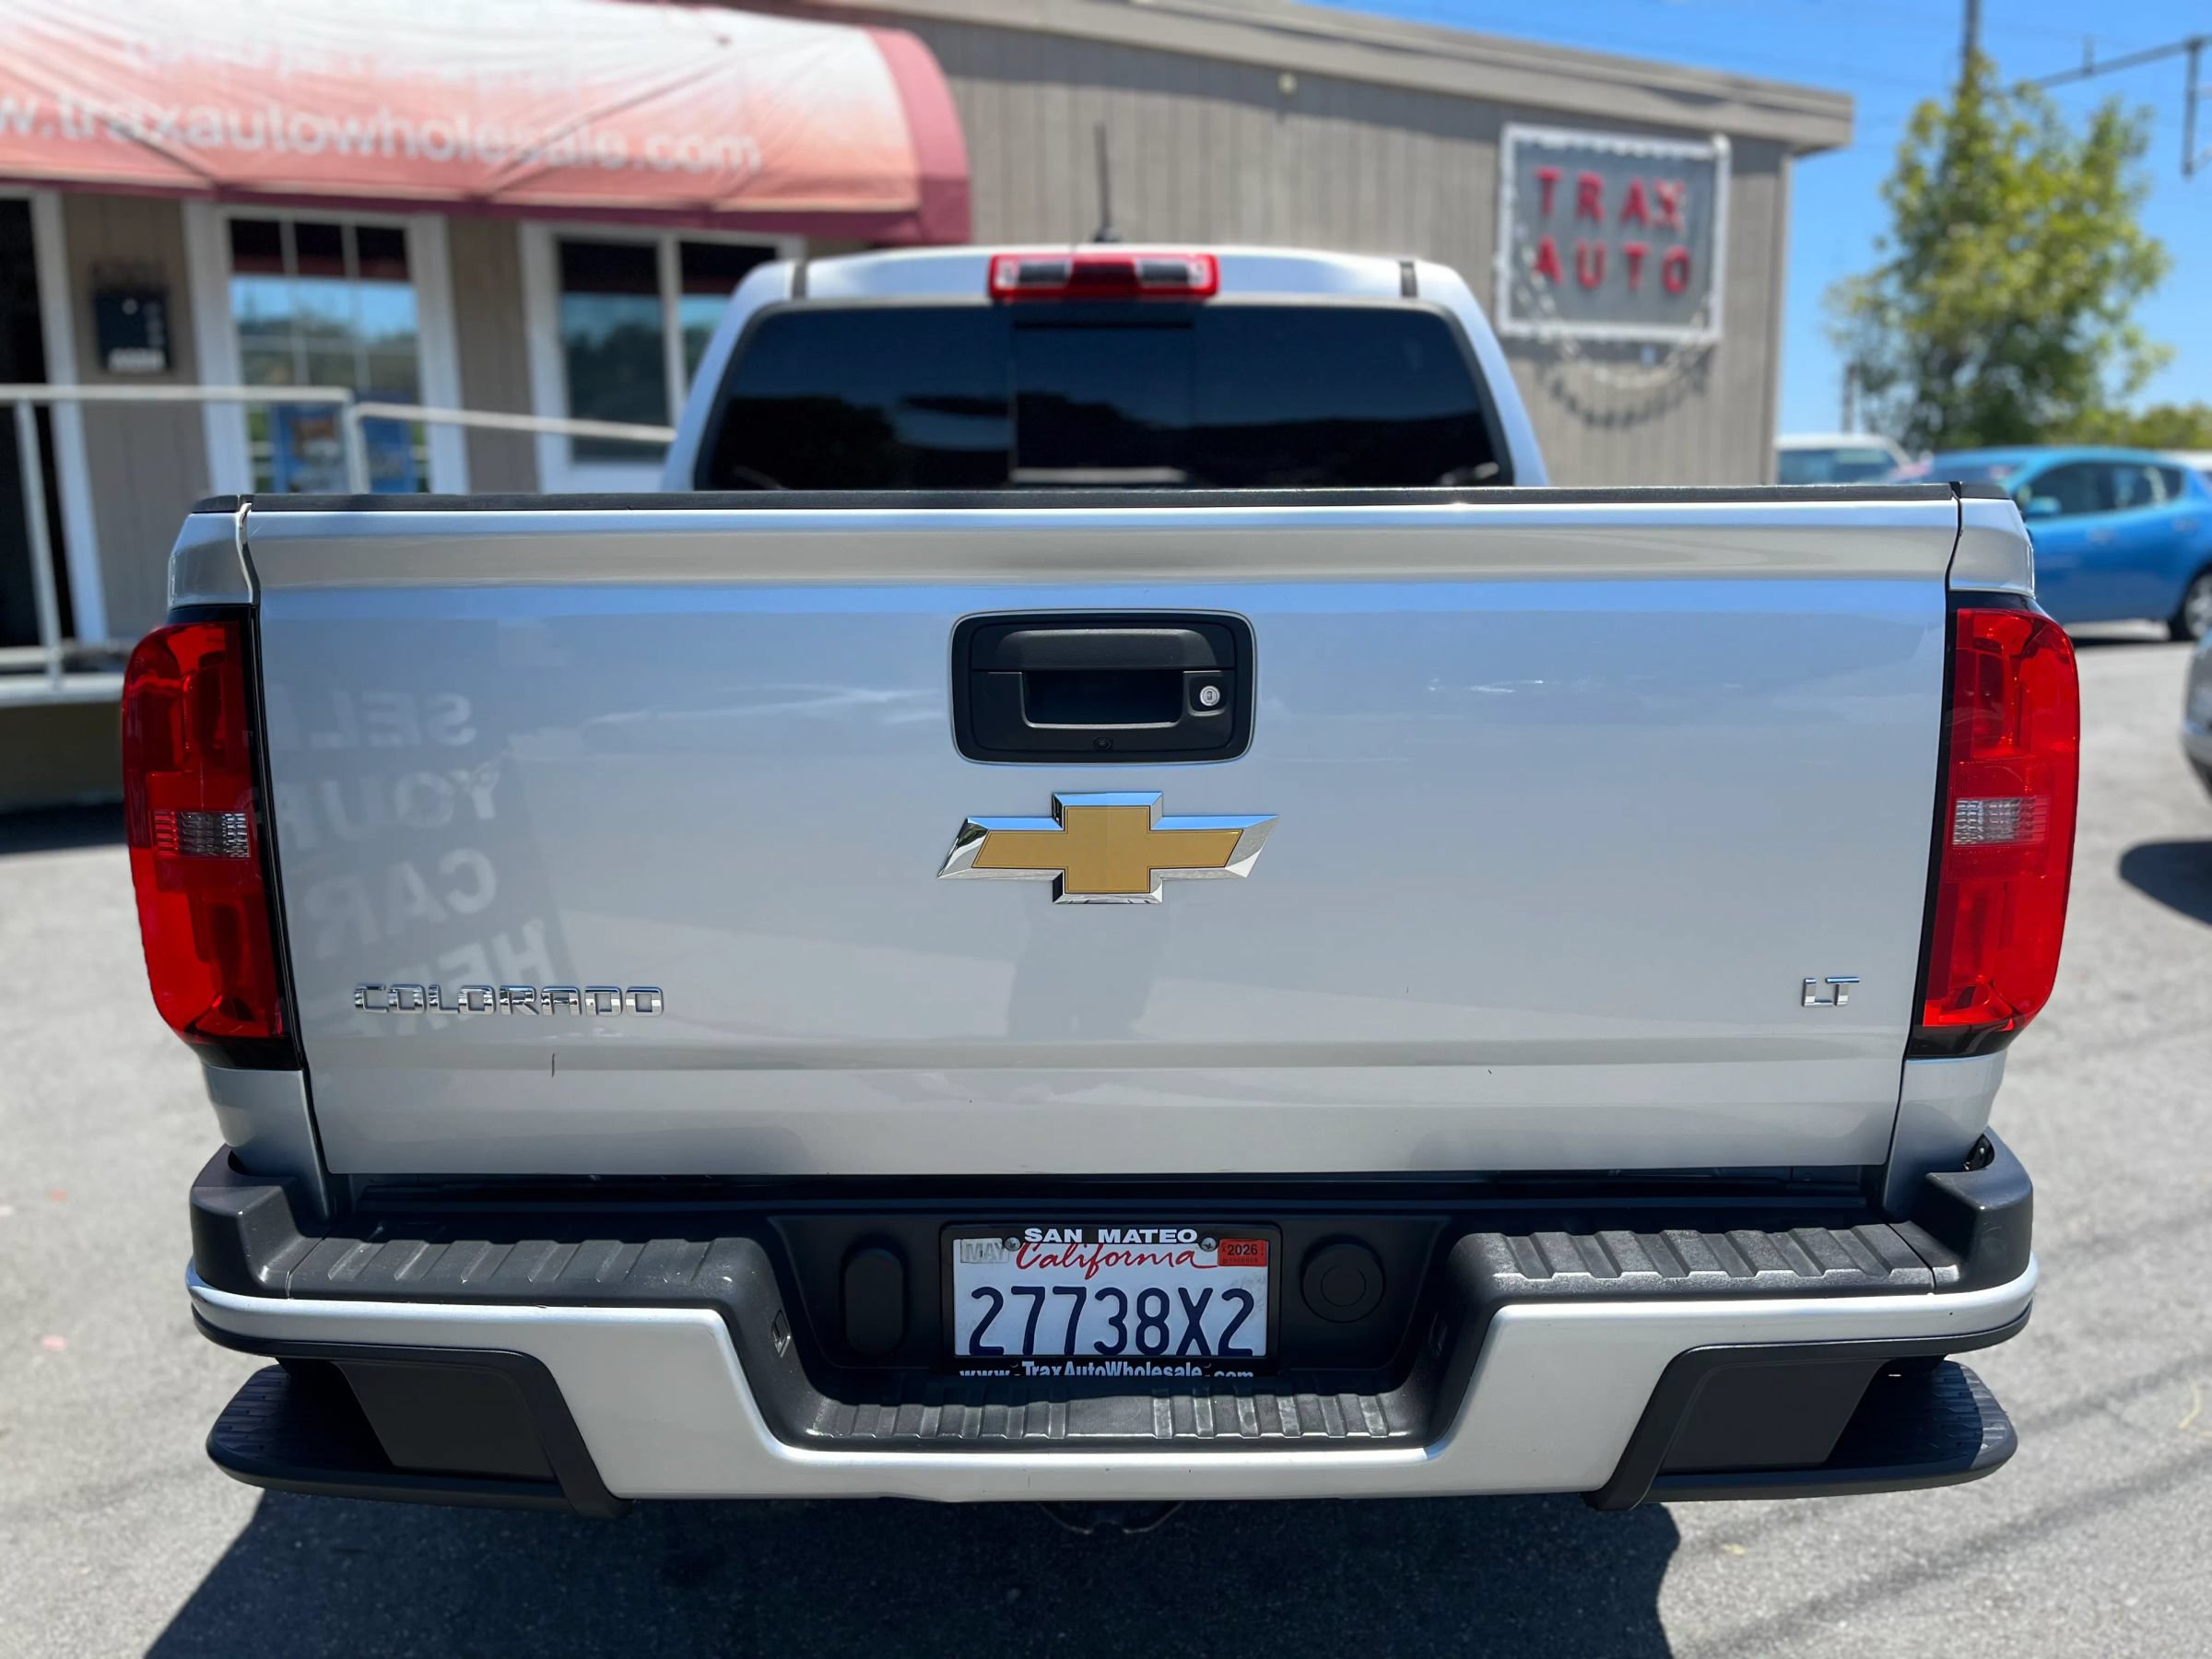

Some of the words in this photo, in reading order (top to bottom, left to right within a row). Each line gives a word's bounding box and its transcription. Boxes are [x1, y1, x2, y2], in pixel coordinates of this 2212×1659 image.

[1535, 167, 1686, 230] TRAX
[1534, 236, 1691, 294] AUTO
[353, 983, 664, 1017] COLORADO
[1802, 977, 1860, 1007] LT
[966, 1242, 1006, 1261] MAY
[1024, 1228, 1082, 1243] SAN
[1098, 1229, 1197, 1243] MATEO
[1228, 1244, 1258, 1255] 2026
[1016, 1241, 1218, 1280] California
[969, 1285, 1254, 1357] 27738X2
